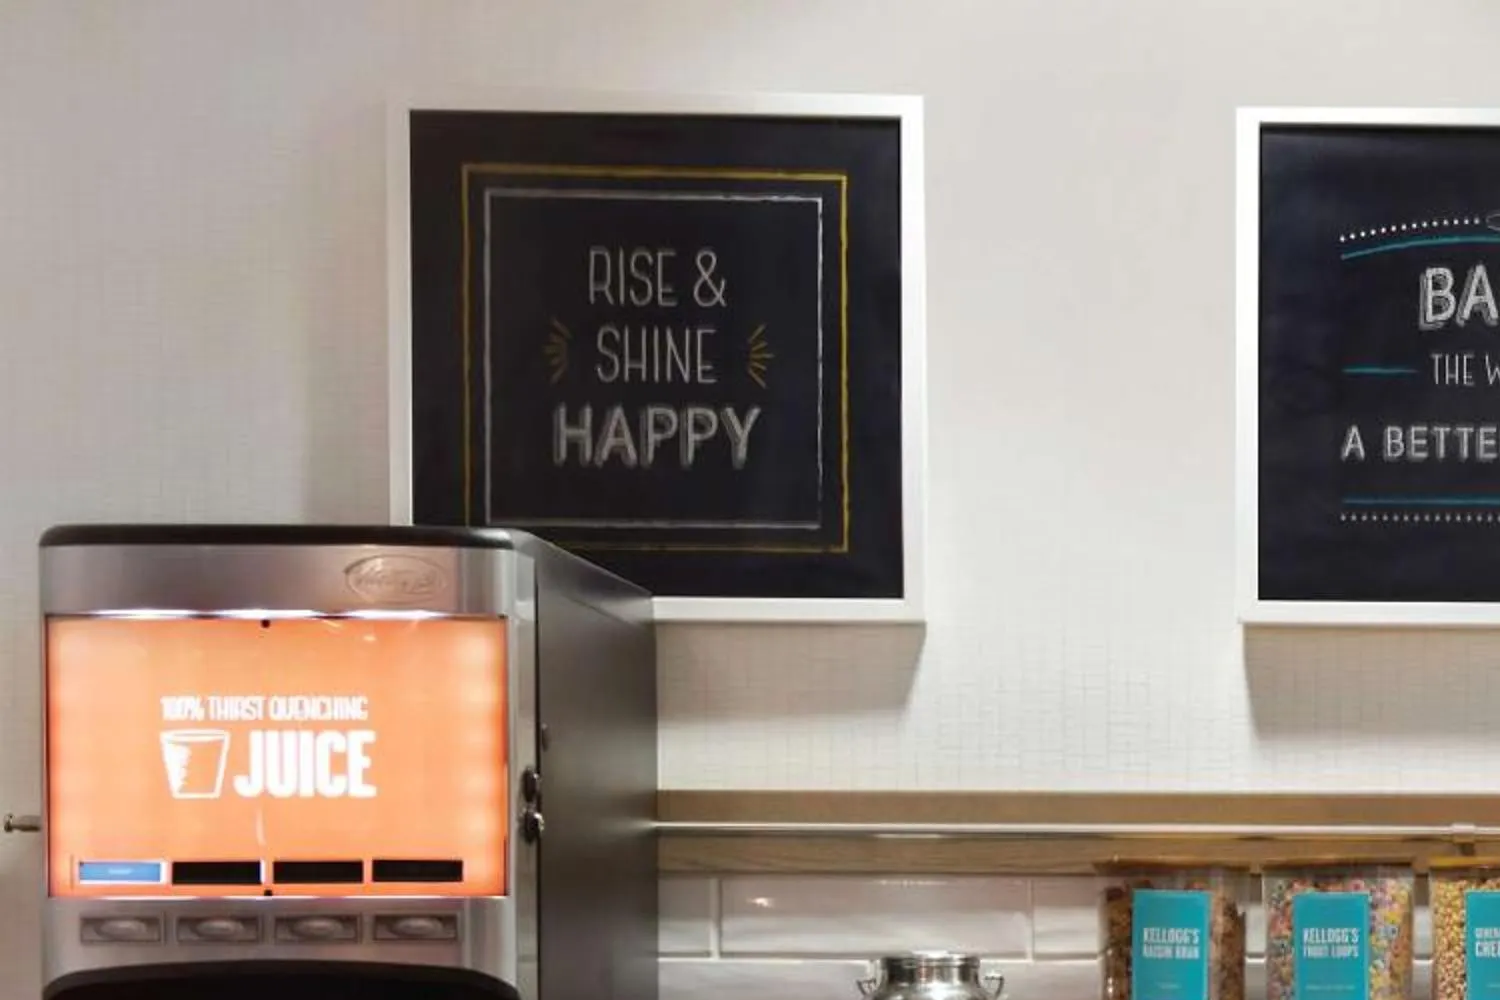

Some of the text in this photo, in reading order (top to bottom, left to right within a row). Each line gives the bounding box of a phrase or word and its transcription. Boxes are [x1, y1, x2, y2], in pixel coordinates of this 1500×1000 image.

[588, 247, 727, 307] RISE &
[596, 325, 718, 384] SHINE
[1430, 353, 1475, 386] THE
[553, 404, 761, 469] HAPPY
[1341, 425, 1365, 461] A
[208, 695, 265, 721] THIRST
[269, 695, 368, 721] QUENCHING
[233, 729, 377, 798] JUICE
[1302, 927, 1360, 945] KELLOGG'S
